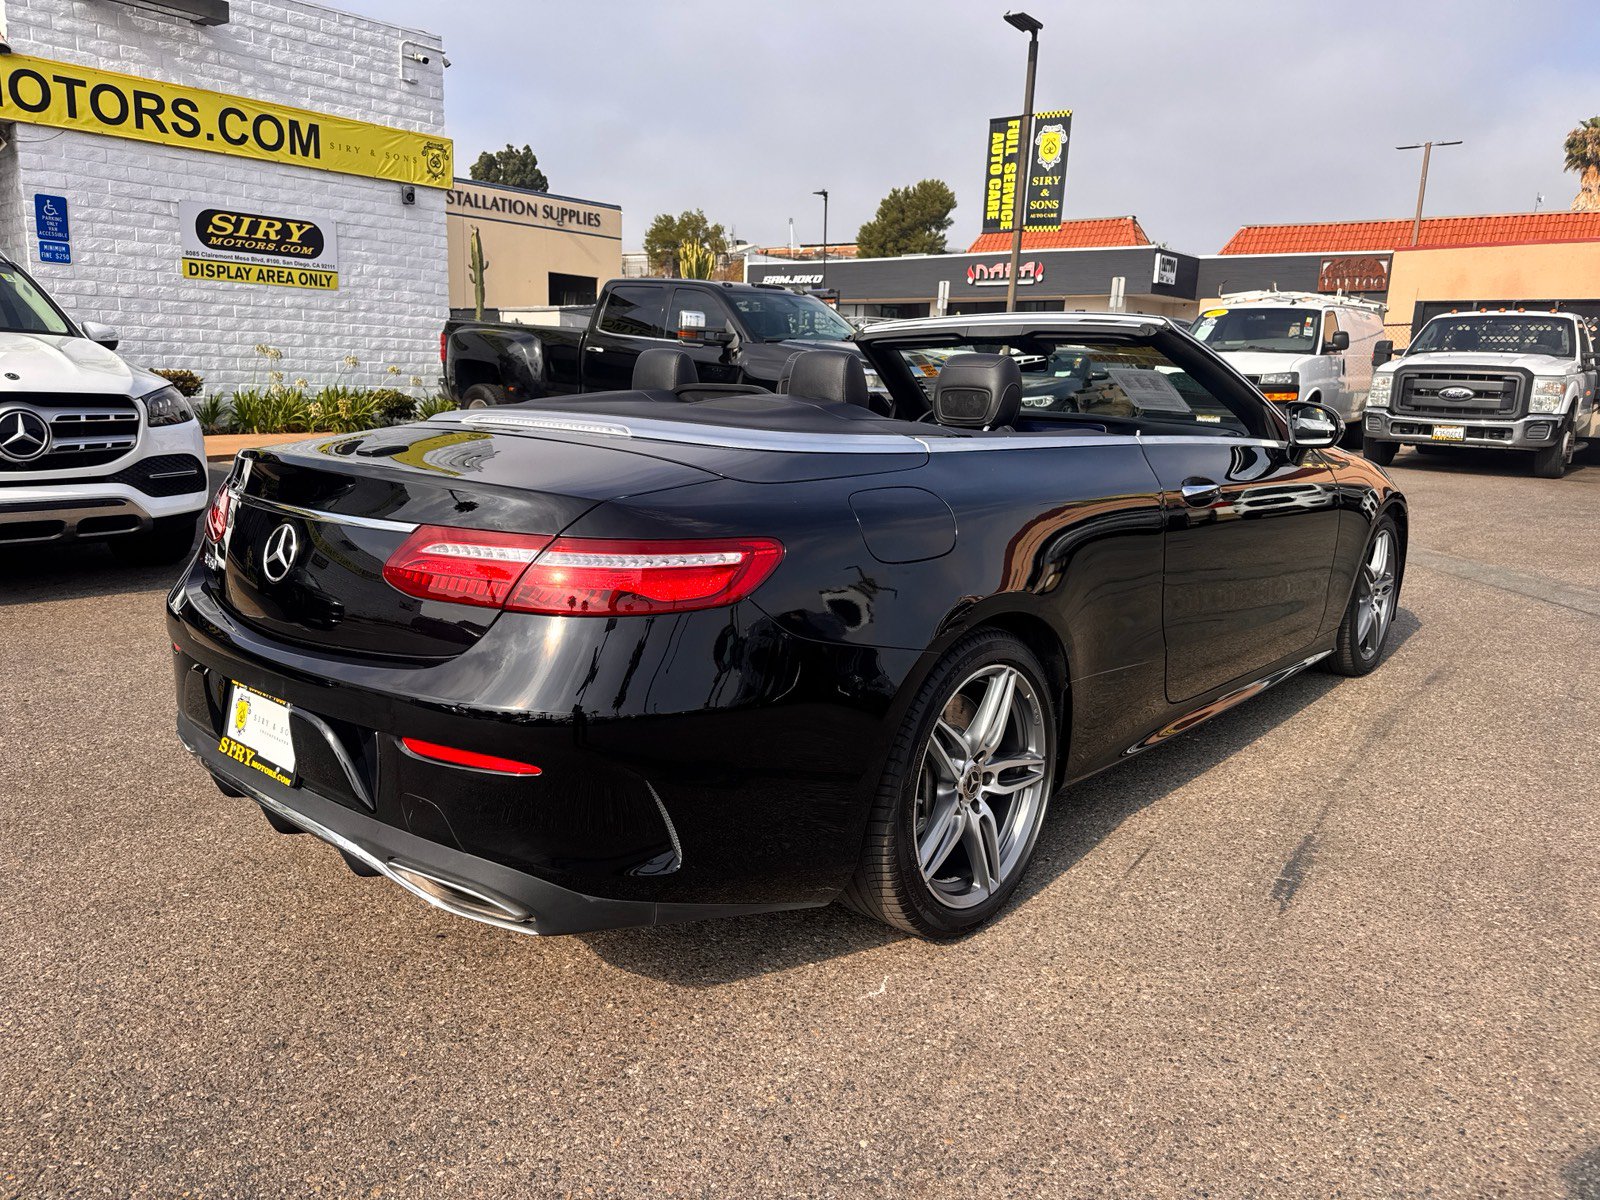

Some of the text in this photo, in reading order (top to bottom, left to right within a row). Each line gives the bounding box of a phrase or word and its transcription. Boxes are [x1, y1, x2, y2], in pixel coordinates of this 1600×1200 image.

[0, 67, 321, 160] OTORS.COM
[329, 142, 418, 164] SIRY & SONS
[986, 132, 1005, 220] AUTO CARE
[1000, 120, 1021, 231] FULL SERVICE
[1032, 176, 1061, 186] SIRY
[1040, 188, 1050, 197] &
[542, 204, 601, 228] SUPPLIES
[1029, 200, 1060, 210] SONS
[39, 231, 68, 239] ACCESSIBLE
[207, 213, 314, 244] SIRY
[41, 251, 53, 259] FINE
[185, 249, 200, 257] 8085
[200, 251, 234, 260] Clairemont
[208, 236, 315, 256] MOTORS.COM
[188, 262, 333, 288] DISPLAY AREA ONLY
[218, 737, 292, 787] SIRY MOTORS.COM
